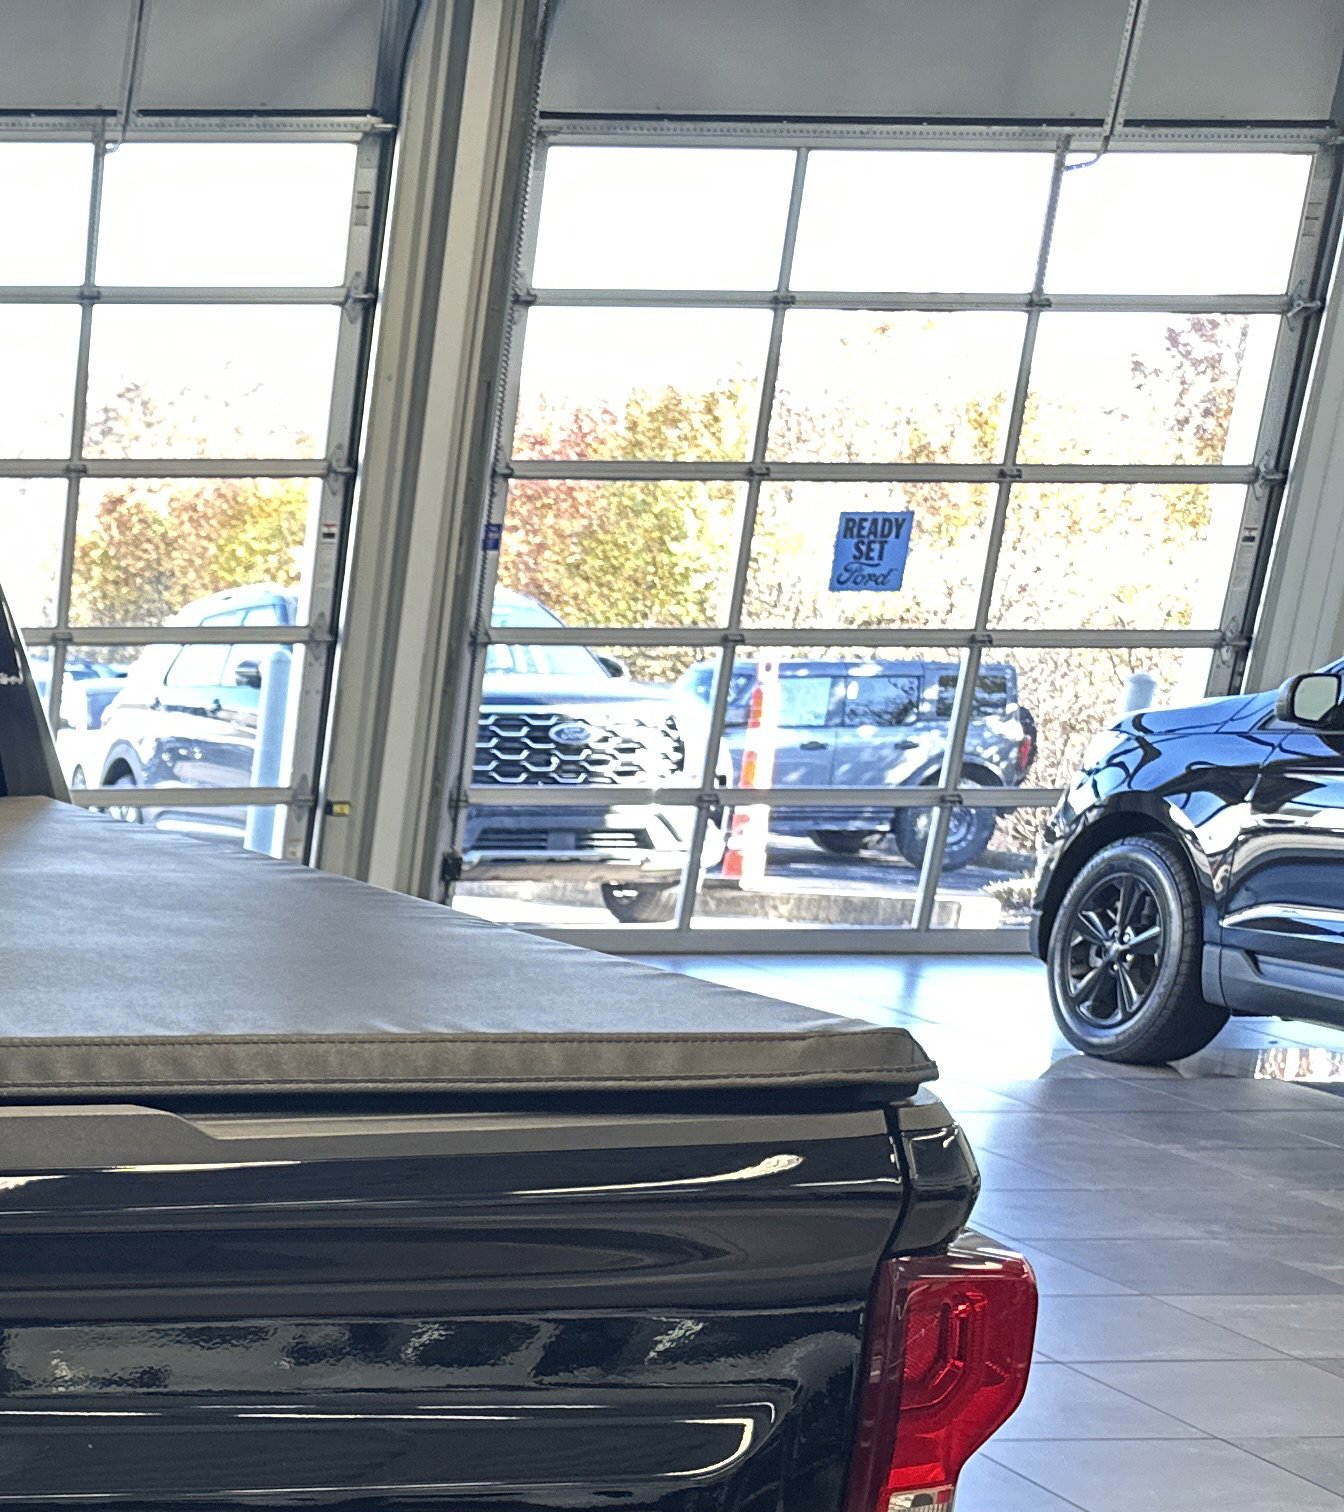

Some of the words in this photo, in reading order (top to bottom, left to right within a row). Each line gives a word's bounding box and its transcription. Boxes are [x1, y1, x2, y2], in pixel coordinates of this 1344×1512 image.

[843, 517, 906, 539] READY
[853, 539, 889, 561] SET
[835, 561, 894, 585] Ford
